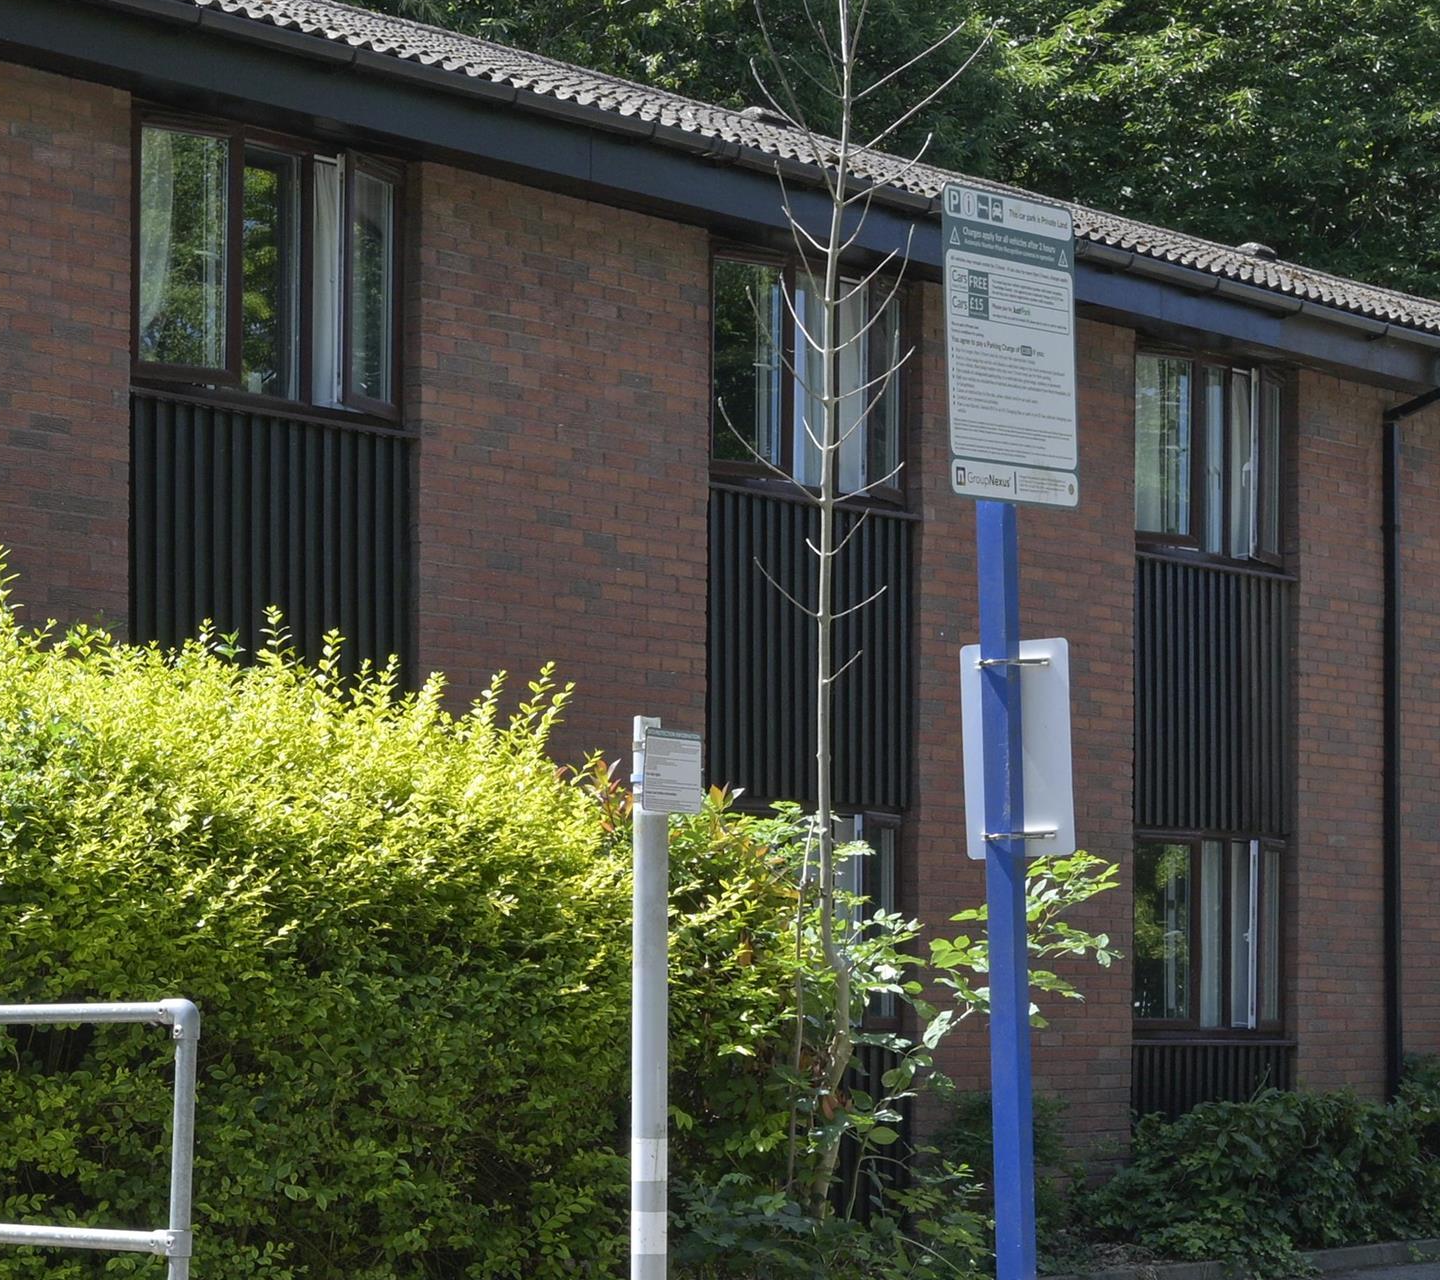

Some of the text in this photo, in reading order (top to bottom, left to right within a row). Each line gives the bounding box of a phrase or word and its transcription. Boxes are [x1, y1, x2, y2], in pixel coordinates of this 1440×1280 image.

[952, 269, 967, 284] Cars
[969, 275, 988, 290] FREE
[952, 296, 968, 310] Cars
[969, 297, 984, 311] £15
[967, 471, 1010, 488] GroupNexus
